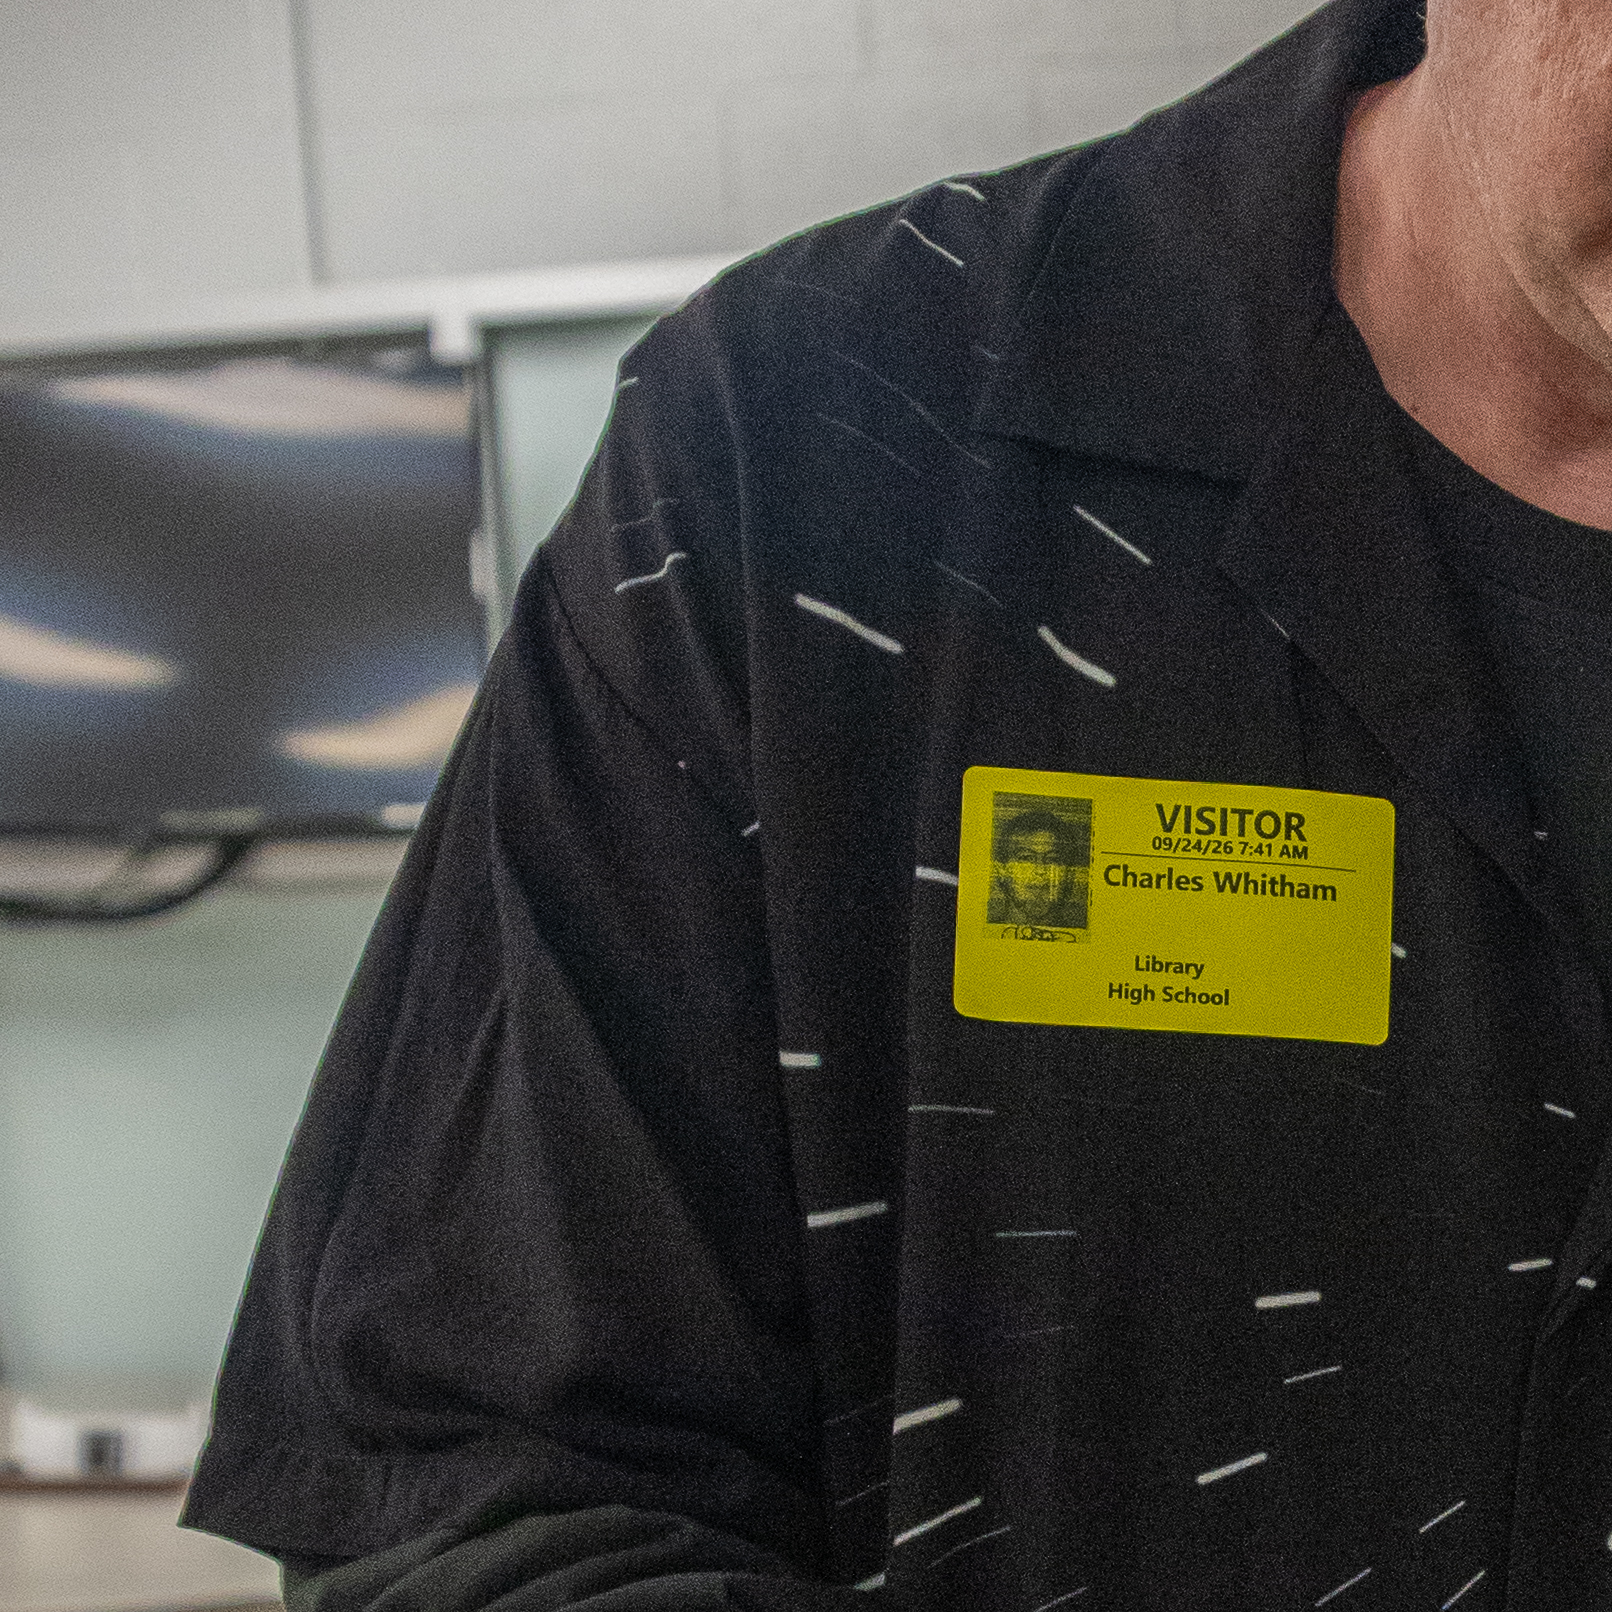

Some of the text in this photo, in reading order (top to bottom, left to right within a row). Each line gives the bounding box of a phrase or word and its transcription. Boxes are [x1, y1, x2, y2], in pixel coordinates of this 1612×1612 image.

[1155, 803, 1307, 842] VISITOR
[1152, 835, 1308, 860] 09/24/26 7:41 AM
[1103, 864, 1337, 902] Charles Whitham
[1134, 955, 1205, 979] Library
[1107, 982, 1230, 1006] High School
